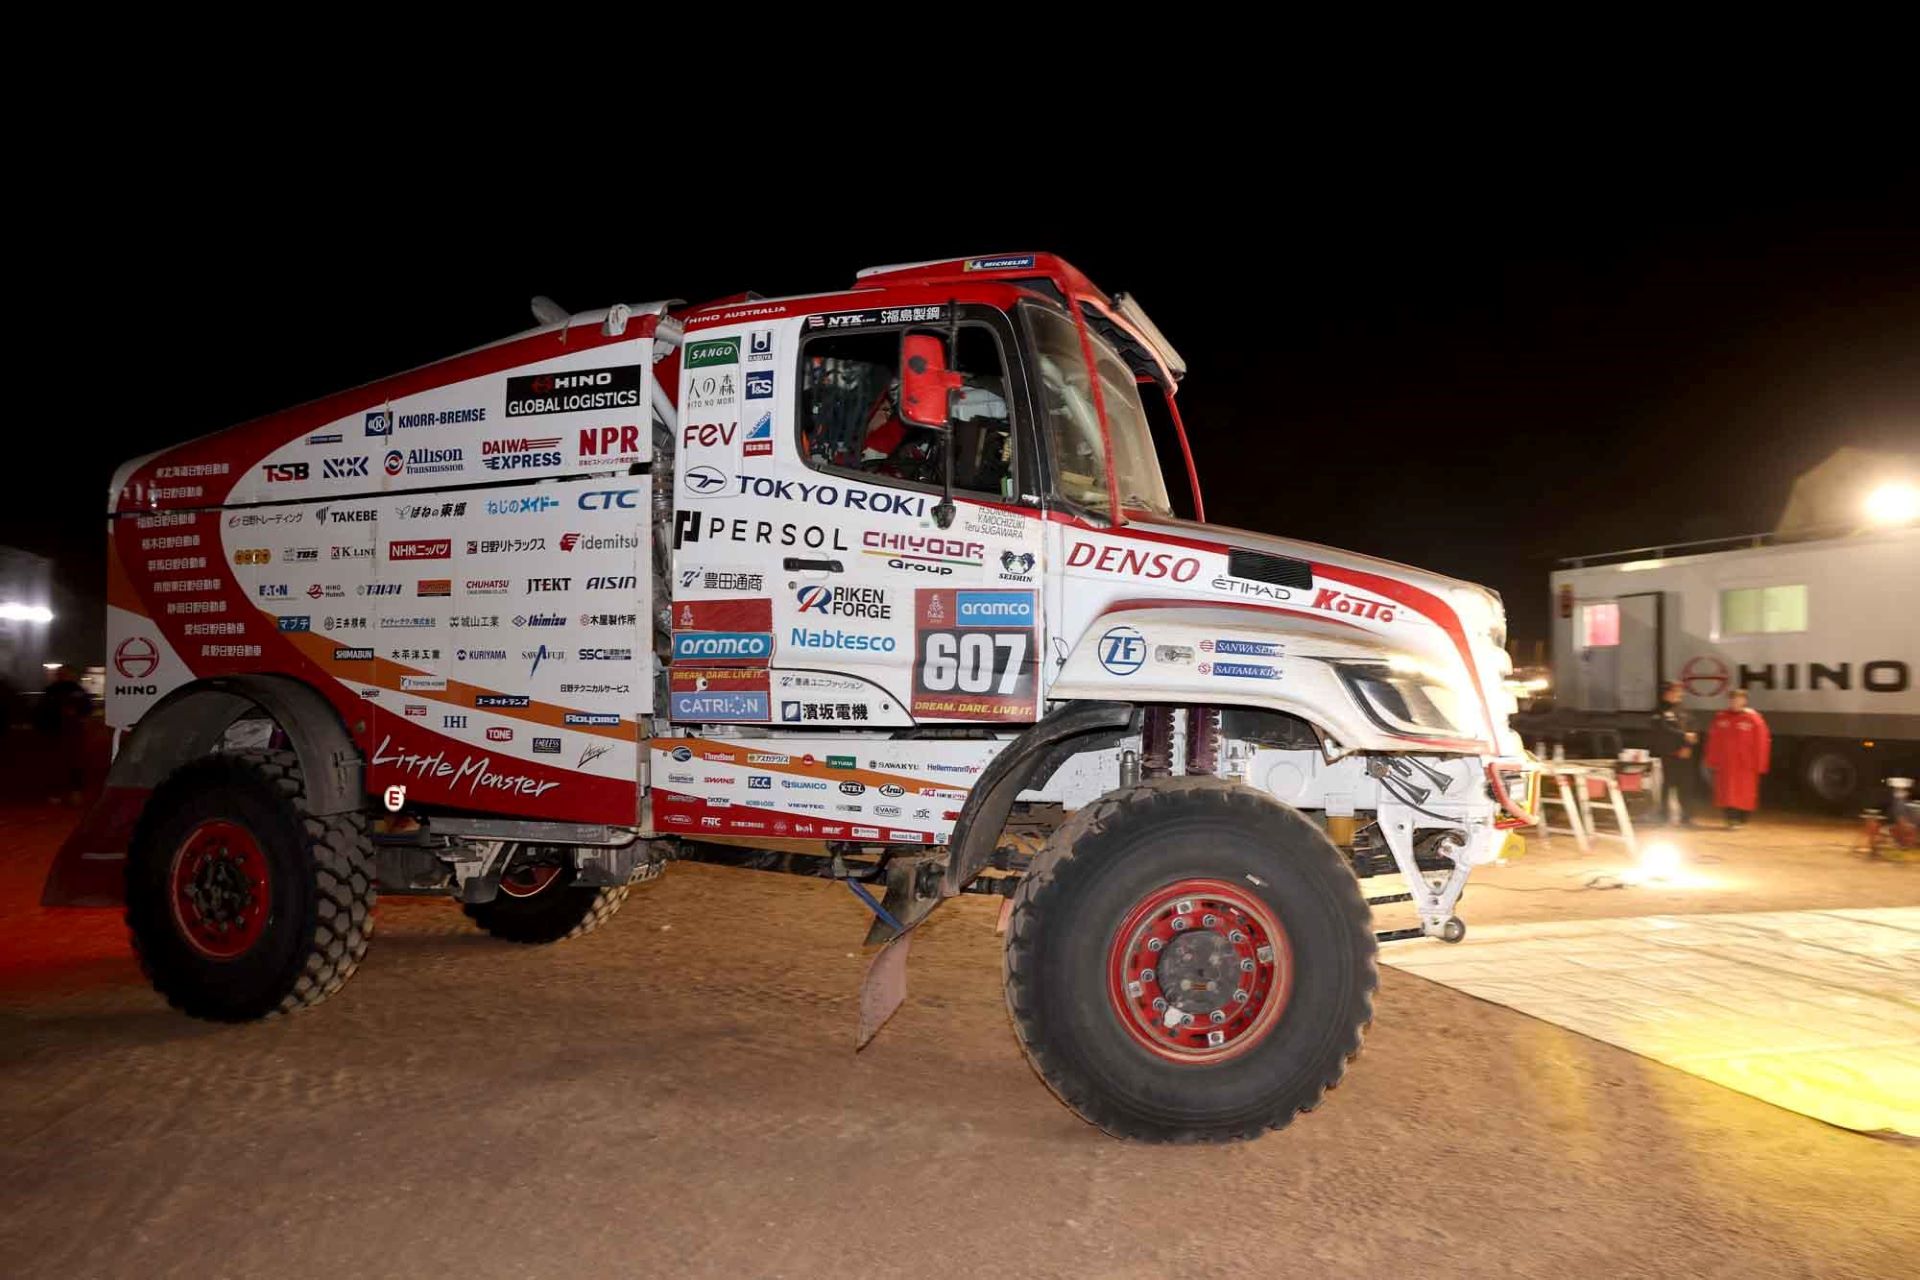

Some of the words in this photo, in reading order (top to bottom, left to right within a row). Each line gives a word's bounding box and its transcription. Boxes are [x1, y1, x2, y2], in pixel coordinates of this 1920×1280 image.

[983, 259, 1028, 267] MICHELIN
[688, 315, 721, 325] HINO
[724, 306, 787, 320] AUSTRALIA
[828, 315, 864, 326] NYK
[692, 345, 733, 361] SANGO
[554, 372, 613, 390] HINO
[688, 373, 736, 400] 人の森
[508, 397, 560, 415] GLOBAL
[563, 389, 639, 410] LOGISTICS
[399, 407, 487, 429] KNORR-BREMSE
[482, 438, 529, 456] DAIWA
[579, 425, 639, 456] NPR
[407, 447, 464, 465] Allison
[490, 451, 562, 471] EXPRESS
[262, 462, 310, 483] TSB
[406, 462, 464, 476] Transmission
[578, 489, 640, 511] CTC
[735, 474, 838, 506] TOKYO
[844, 488, 925, 517] ROKI
[331, 509, 378, 524] TAKEBE
[709, 517, 849, 551] PERSOL
[981, 523, 1024, 540] SUGAWARA
[581, 532, 640, 551] idemitsu
[887, 558, 953, 577] Group
[1065, 541, 1201, 583] DENSO
[466, 580, 510, 589] CHUHATSU
[526, 578, 572, 595] JTEKT
[586, 576, 637, 590] AISIN
[703, 571, 764, 592] 豊田通商
[998, 573, 1033, 584] SEISHIN
[833, 586, 885, 604] RIKEN
[832, 602, 892, 620] FORGE
[961, 601, 1031, 617] aramco
[679, 638, 765, 655] aramco
[791, 627, 897, 653] Nabtesco
[1218, 641, 1254, 654] SANWA
[469, 650, 507, 661] KURIYAMA
[578, 649, 605, 660] SSC
[922, 632, 1028, 695] 607
[1215, 664, 1259, 677] SAITAMA
[1737, 660, 1909, 693] HINO
[115, 684, 158, 696] HINO
[914, 702, 957, 713] DREAM.
[959, 703, 991, 714] DARE.
[992, 705, 1018, 715] LIVE
[443, 715, 468, 729] IHI
[488, 729, 512, 740] TONE
[371, 734, 455, 779] Little
[448, 756, 562, 797] Monster
[703, 776, 735, 785] SWANS
[790, 781, 828, 790] SUMICO
[880, 784, 903, 796] Arai
[875, 806, 900, 815] EVANS
